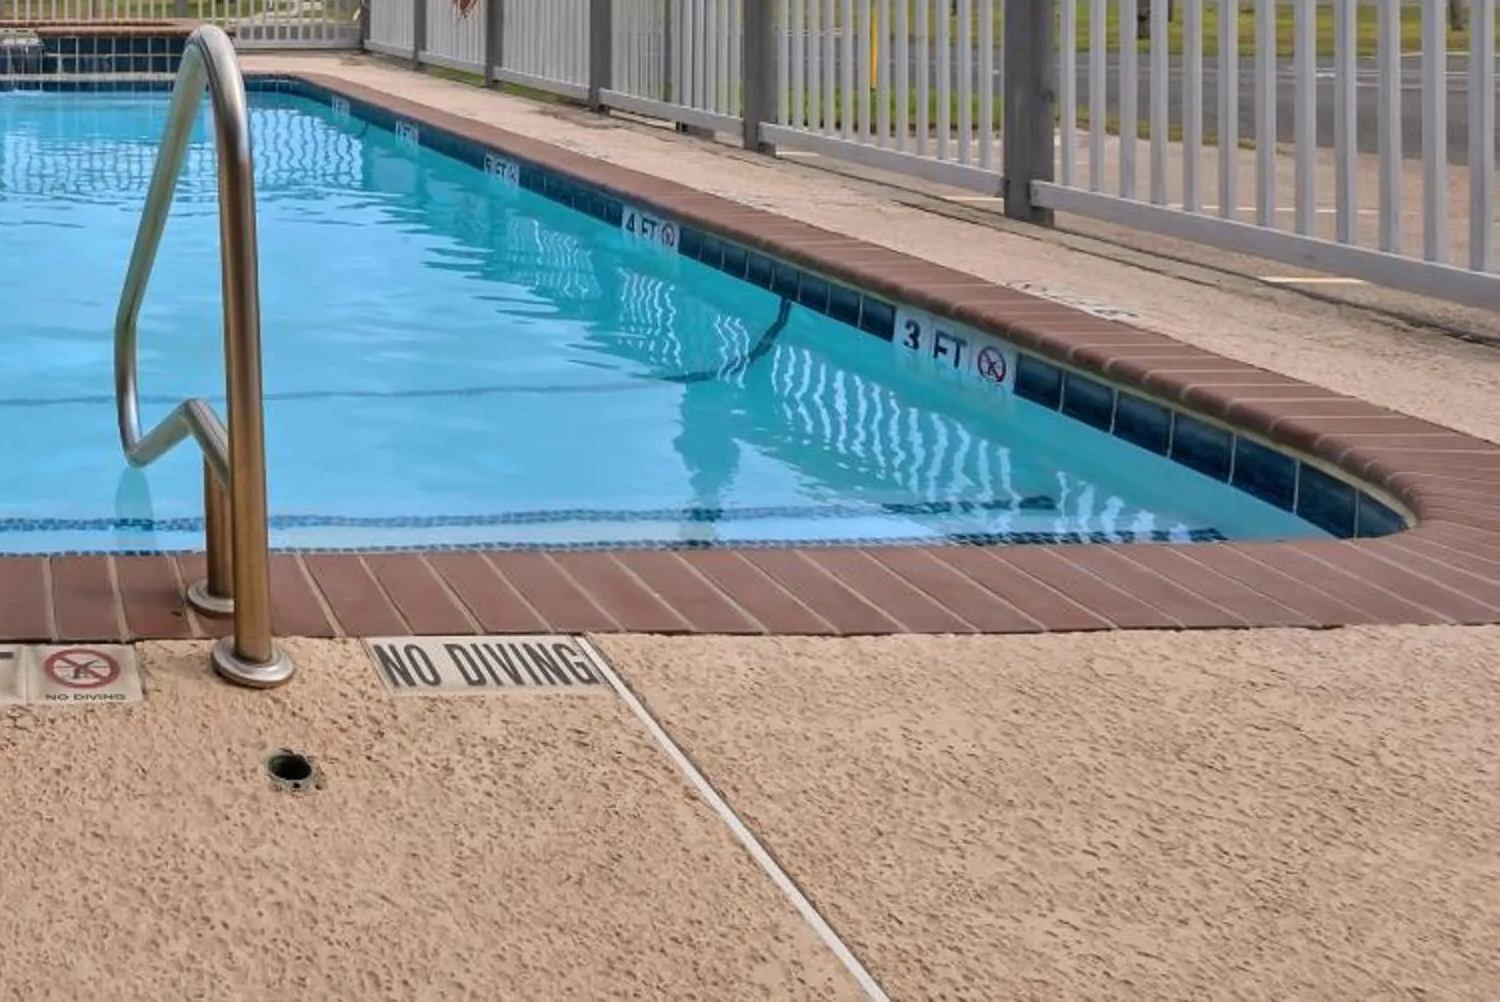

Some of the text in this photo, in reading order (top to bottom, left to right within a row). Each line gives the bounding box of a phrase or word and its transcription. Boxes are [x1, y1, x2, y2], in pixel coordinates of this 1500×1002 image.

[626, 213, 657, 241] 4 FT
[903, 319, 967, 369] 3 FT
[373, 643, 601, 687] NO DIVING
[45, 693, 127, 701] NO DIVING
